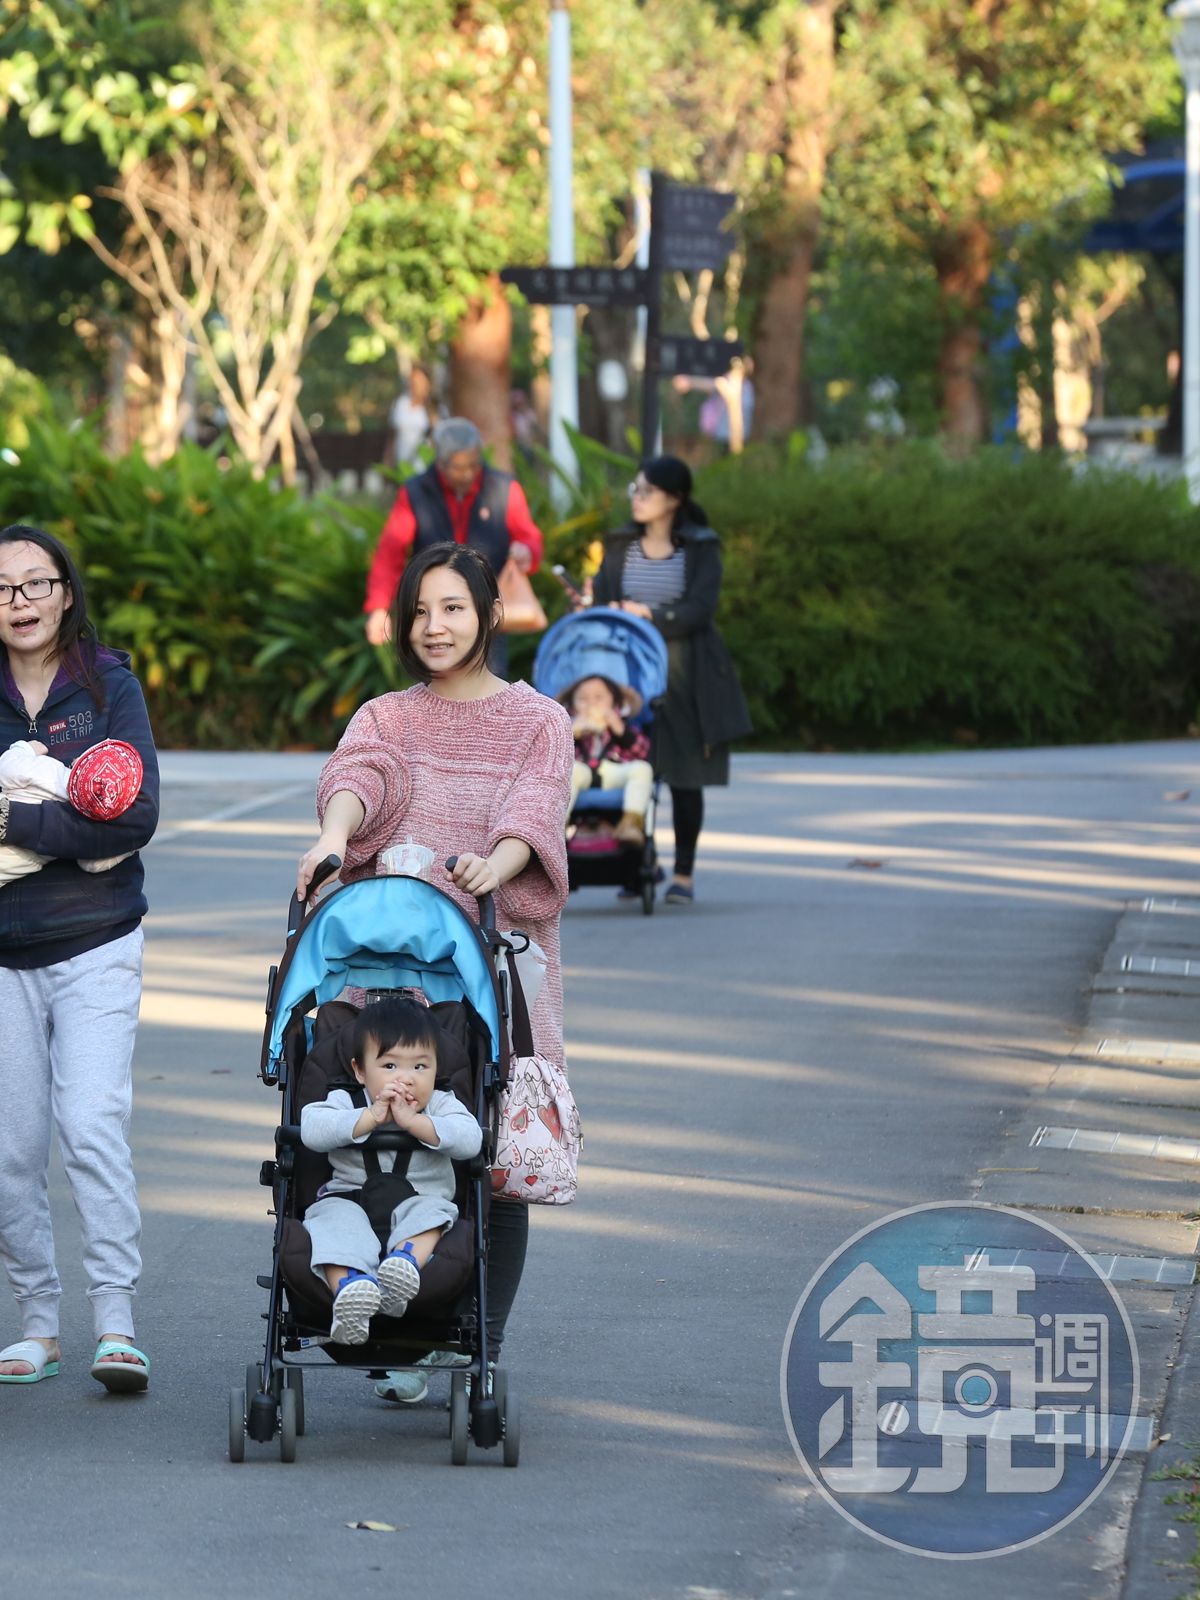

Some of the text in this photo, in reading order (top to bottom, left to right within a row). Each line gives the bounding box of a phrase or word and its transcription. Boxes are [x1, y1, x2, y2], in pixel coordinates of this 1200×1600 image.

[68, 711, 92, 728] 503
[50, 723, 93, 746] BLUE TRIP
